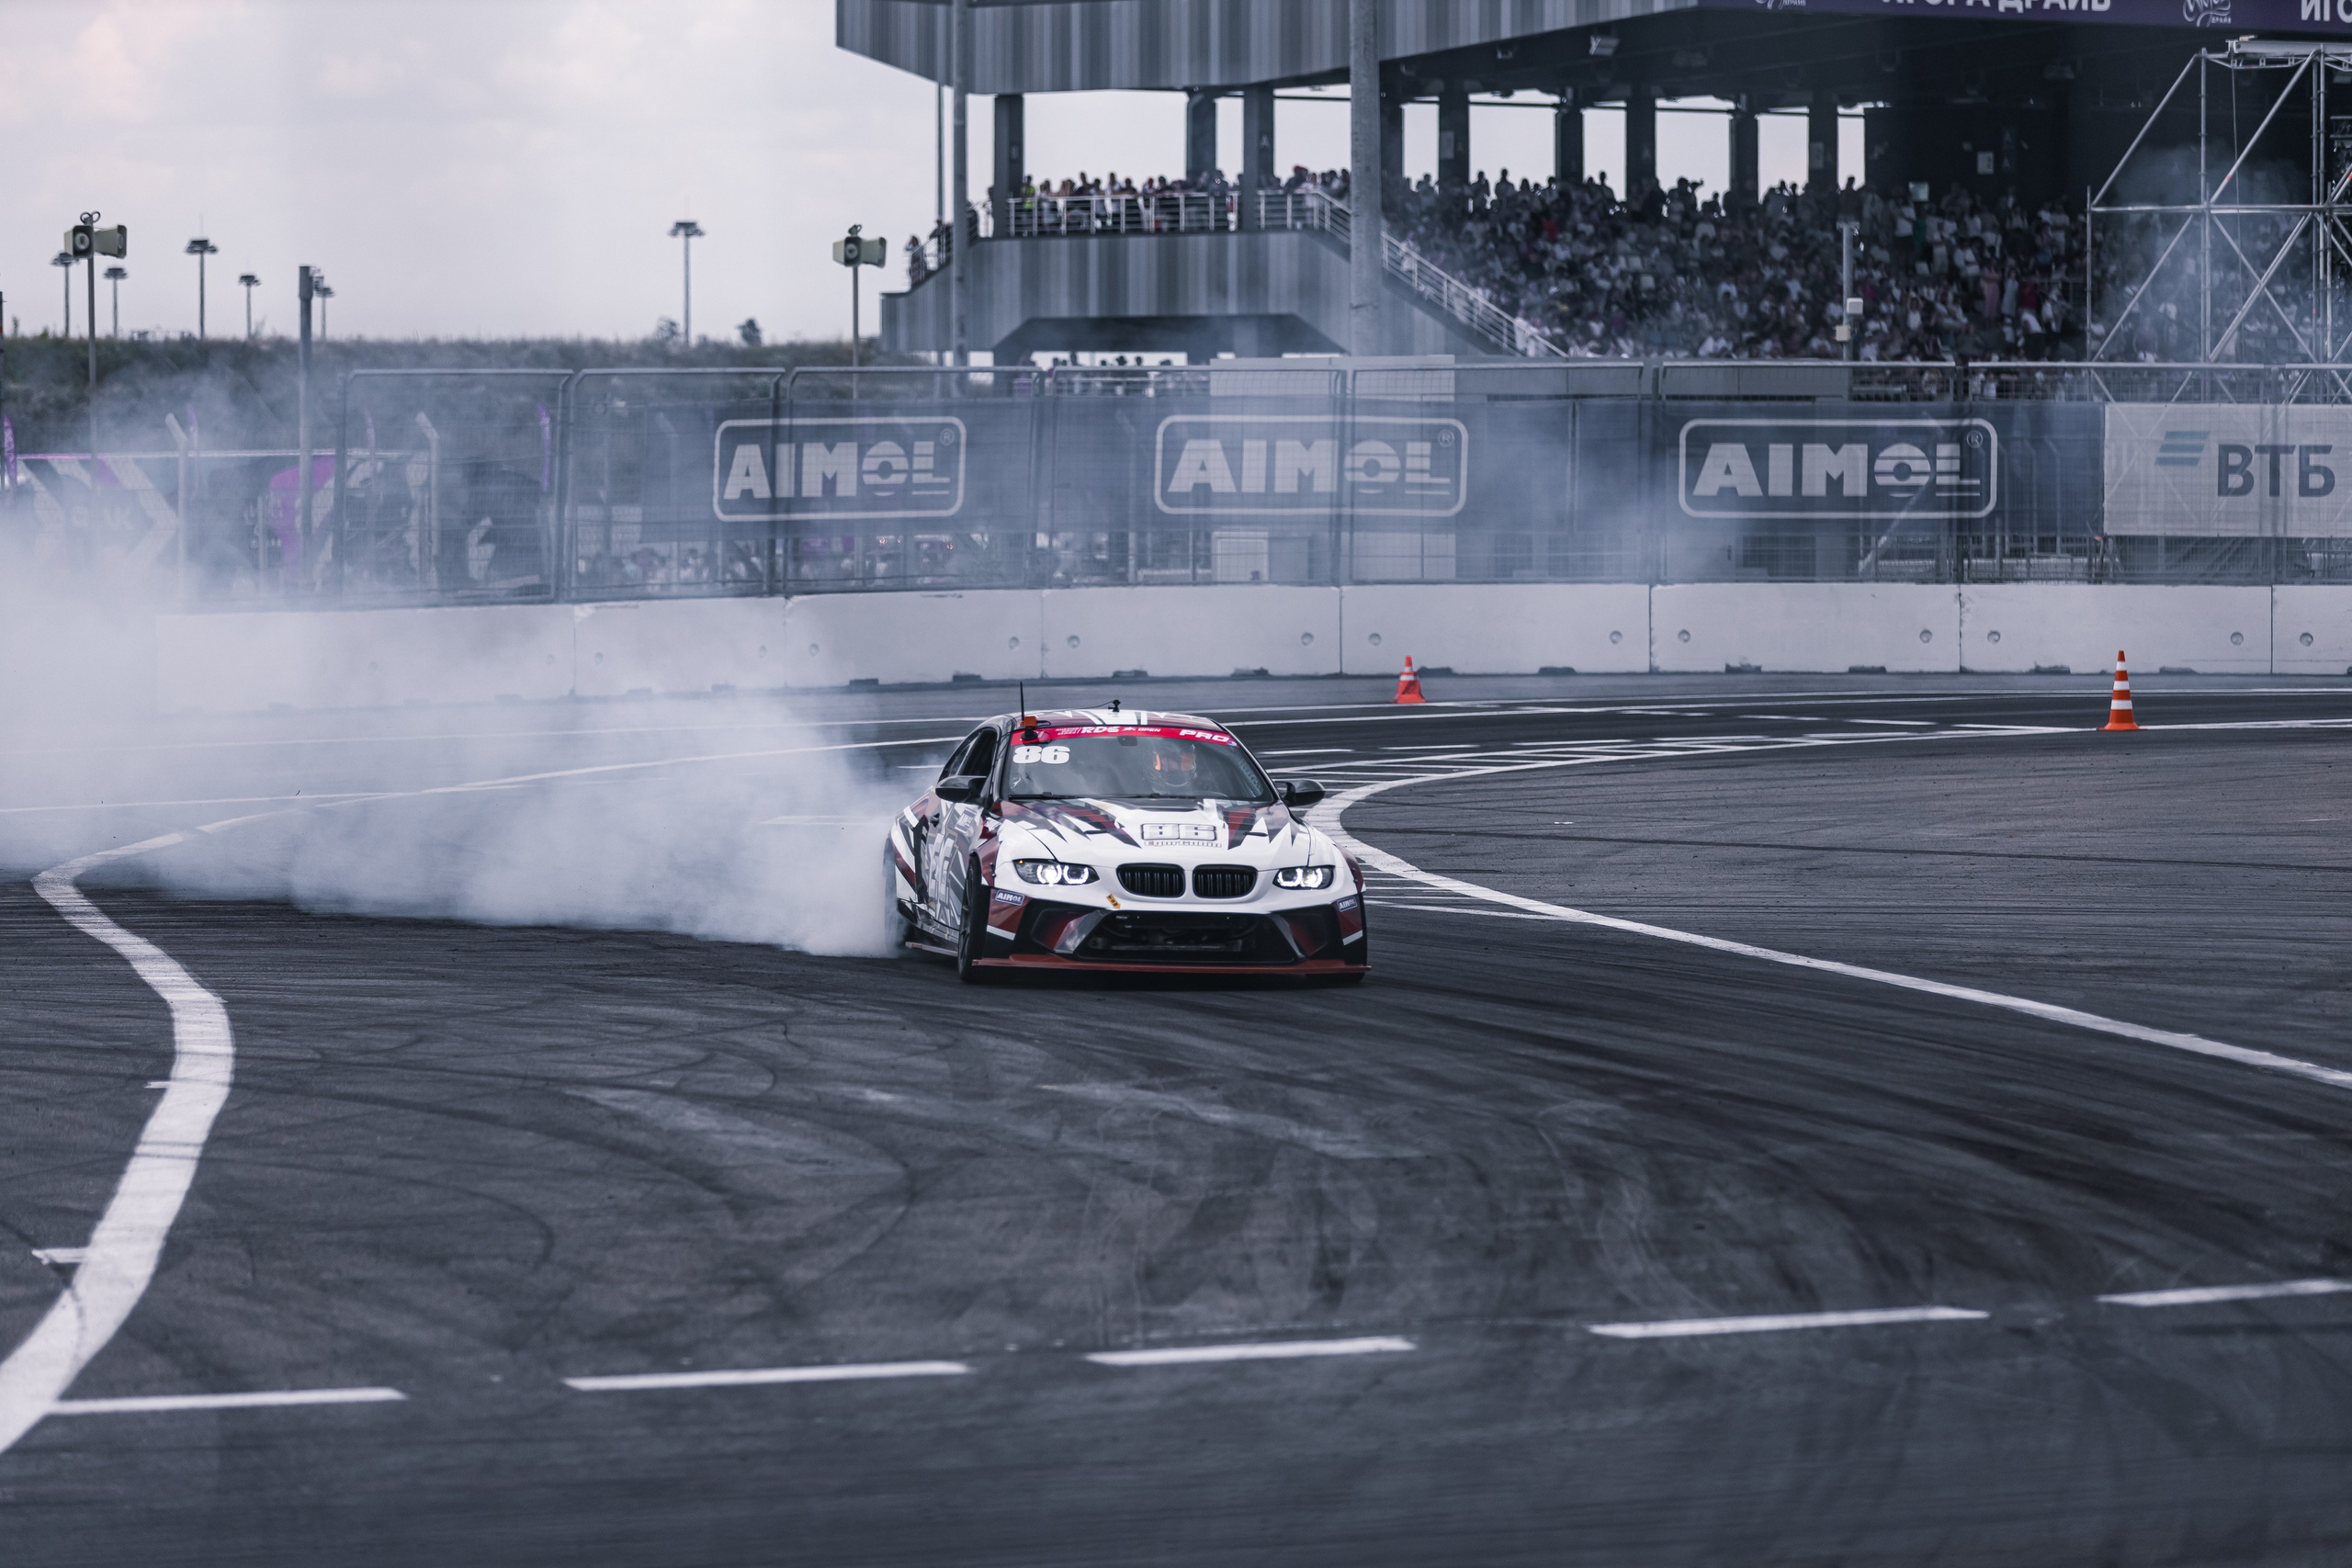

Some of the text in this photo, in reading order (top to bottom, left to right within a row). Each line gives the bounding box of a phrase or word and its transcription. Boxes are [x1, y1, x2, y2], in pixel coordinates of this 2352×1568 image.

[723, 441, 950, 499] AIMOL
[1168, 439, 1451, 495] AIMOL
[1692, 443, 1980, 498] AIMOL
[2218, 444, 2335, 497] ВТБ
[1179, 729, 1230, 743] PRO
[1012, 745, 1070, 764] 86
[1140, 823, 1217, 841] 86
[996, 892, 1023, 903] AIMOL
